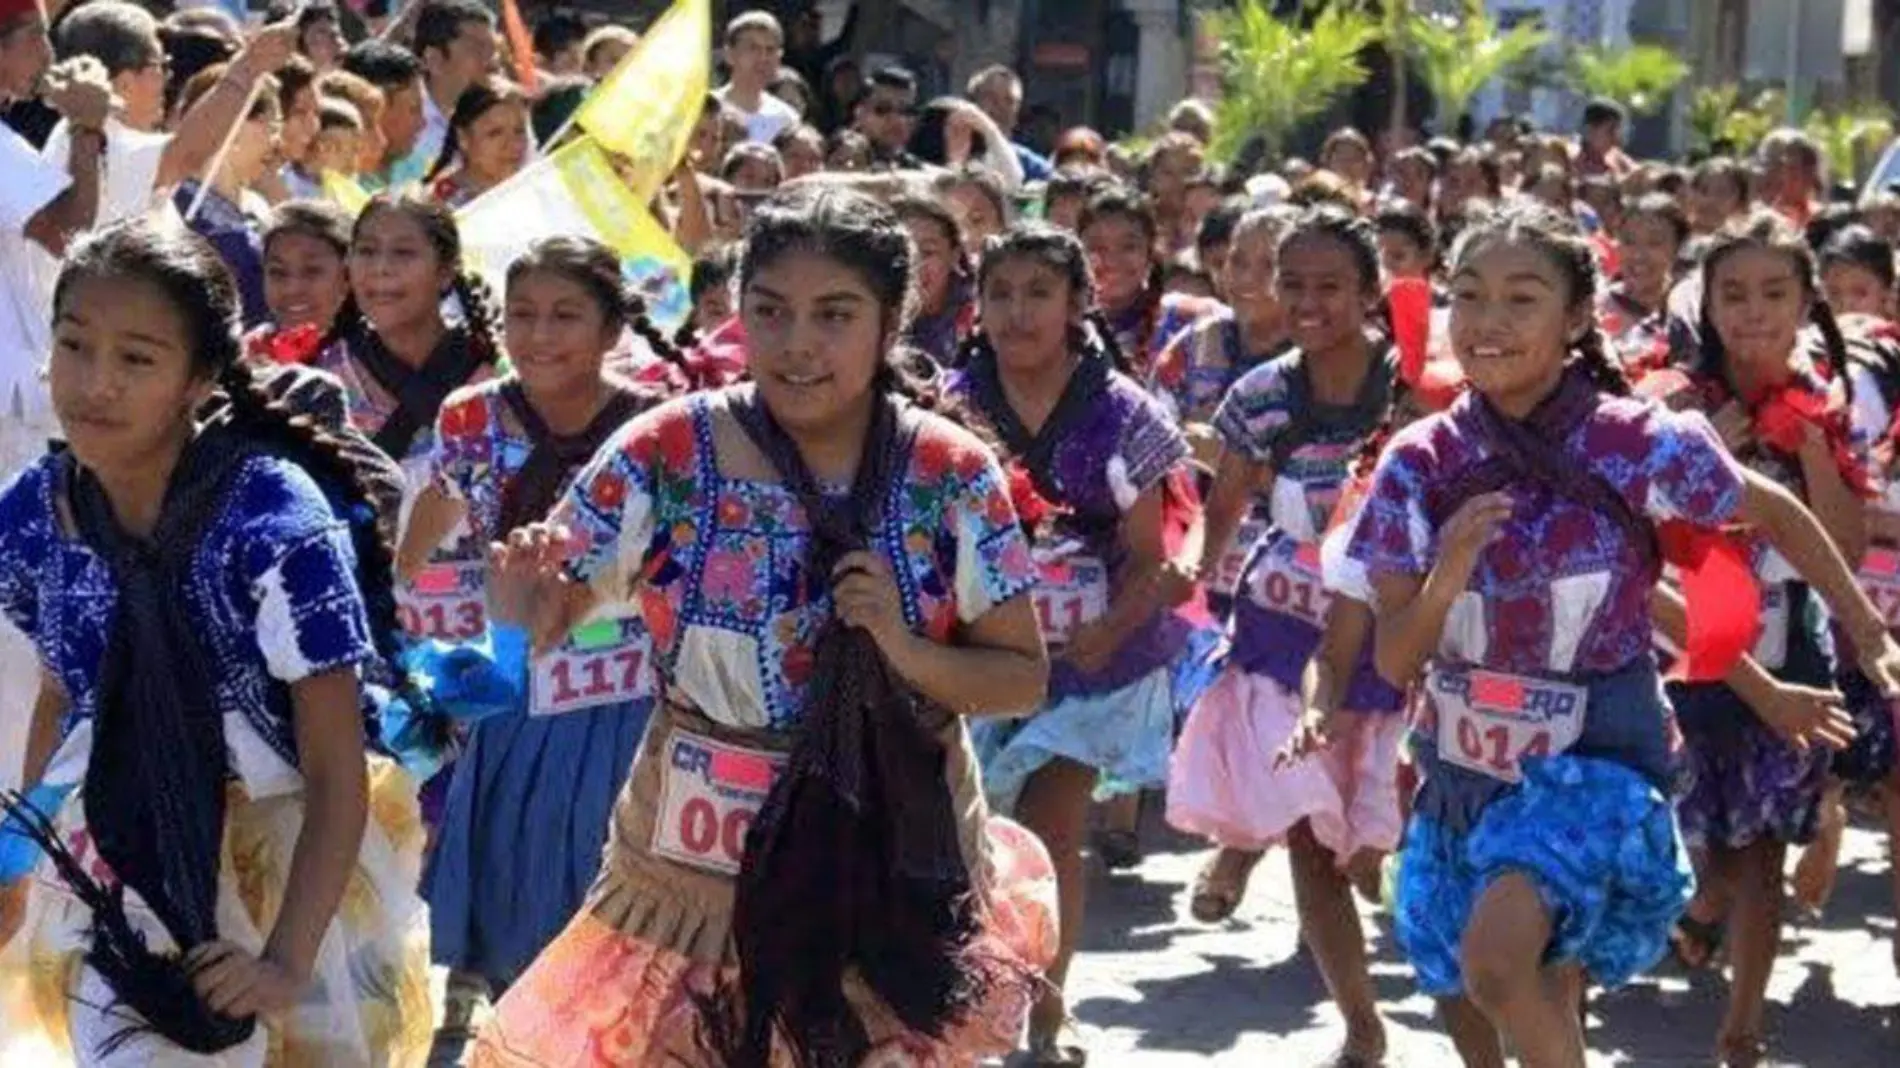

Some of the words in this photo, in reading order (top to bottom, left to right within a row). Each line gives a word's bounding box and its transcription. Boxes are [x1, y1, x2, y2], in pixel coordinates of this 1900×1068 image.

[397, 601, 486, 640] 013
[551, 649, 644, 704] 117
[1457, 716, 1551, 770] 014
